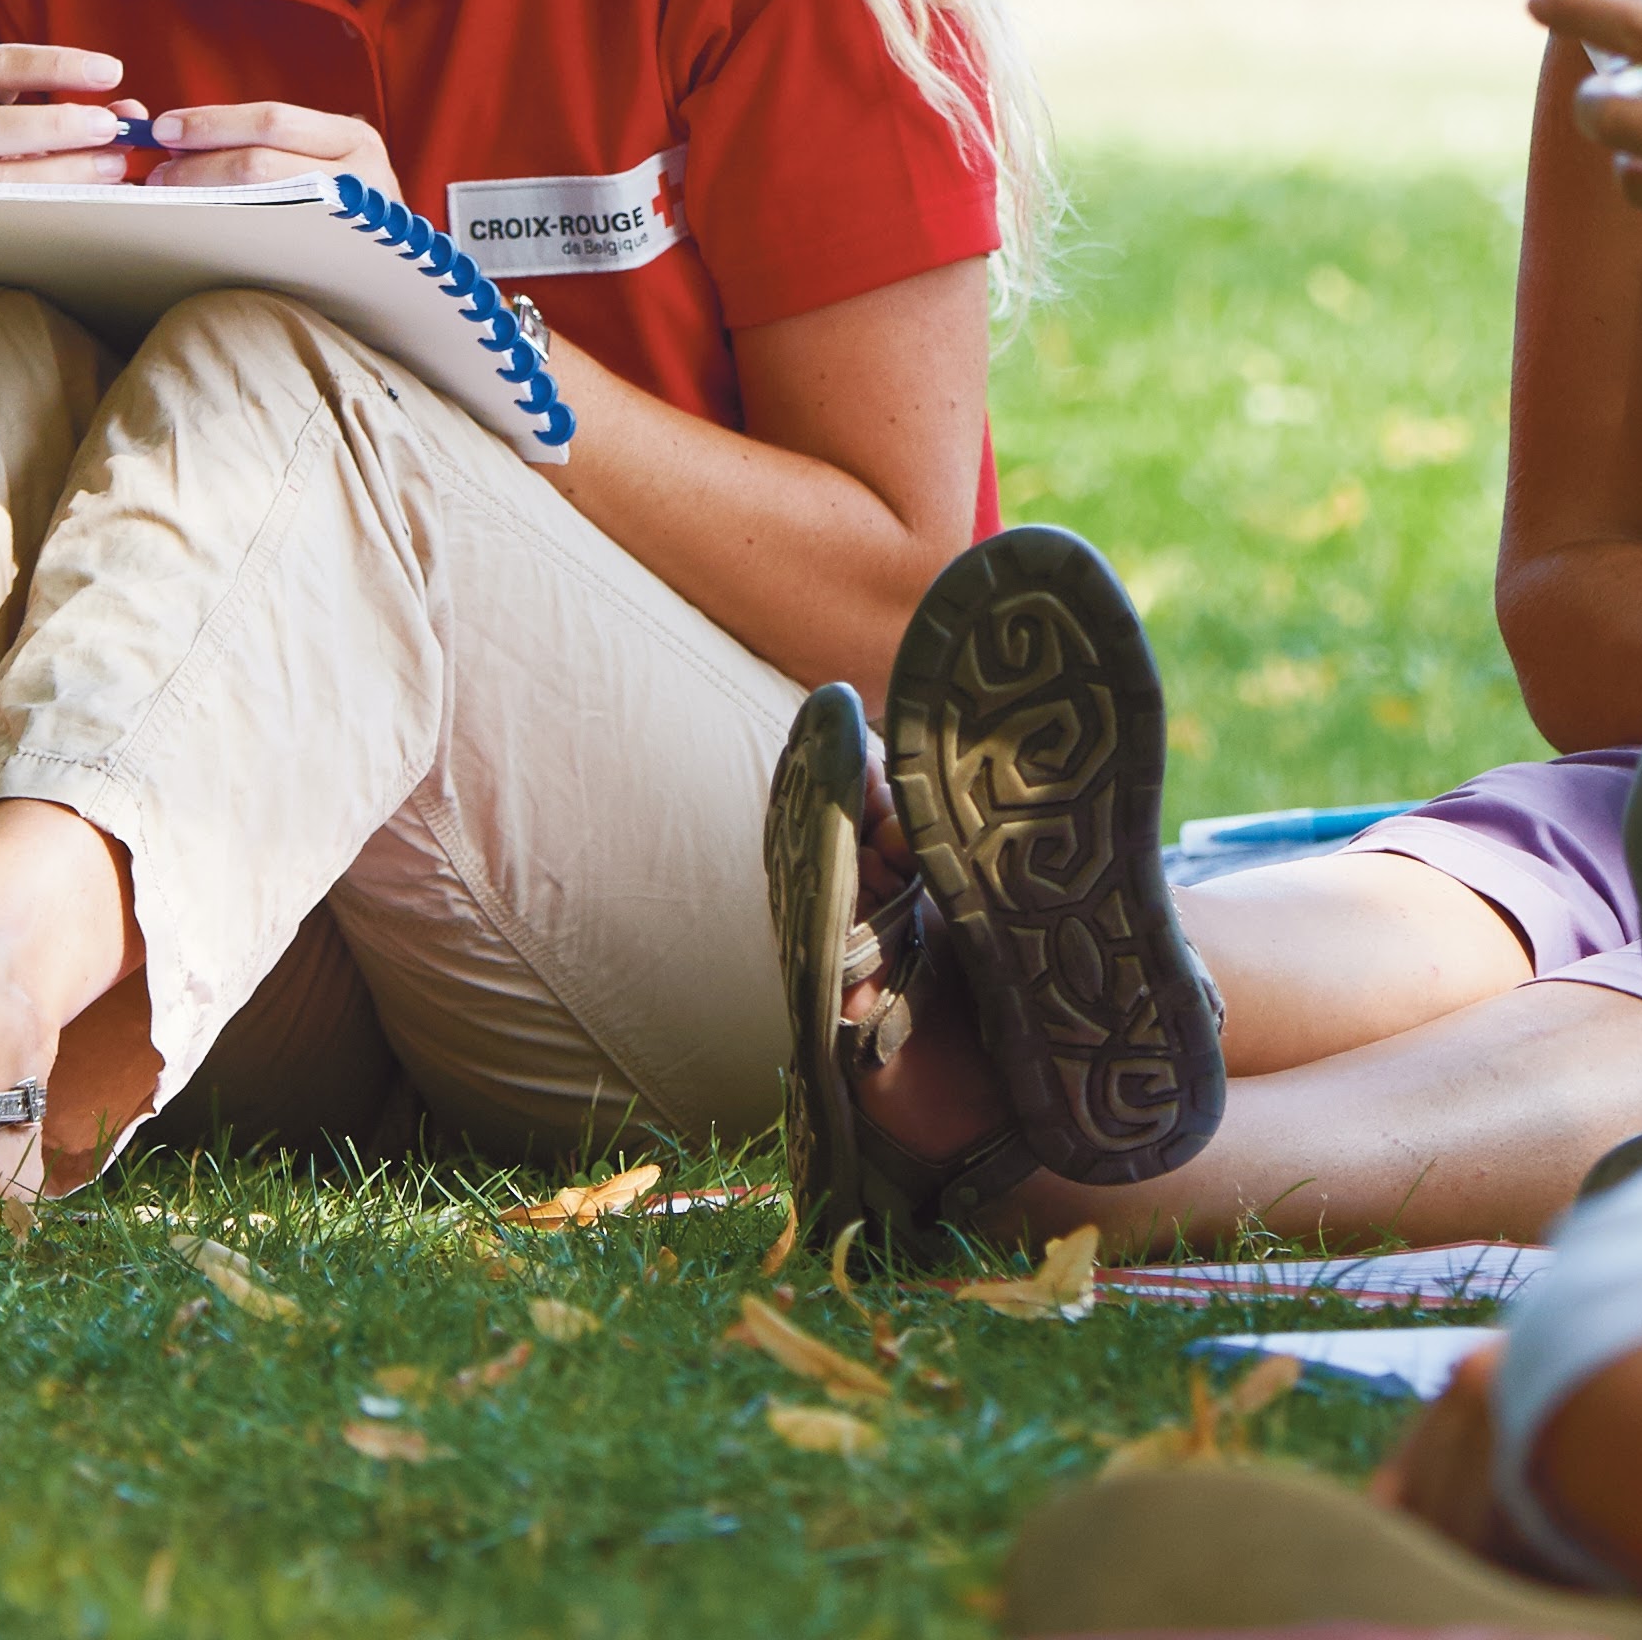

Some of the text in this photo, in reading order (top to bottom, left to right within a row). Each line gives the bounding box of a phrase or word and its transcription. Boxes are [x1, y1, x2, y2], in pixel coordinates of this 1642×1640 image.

[469, 205, 645, 241] CROIX-ROUGE
[561, 231, 649, 258] de Belgique
